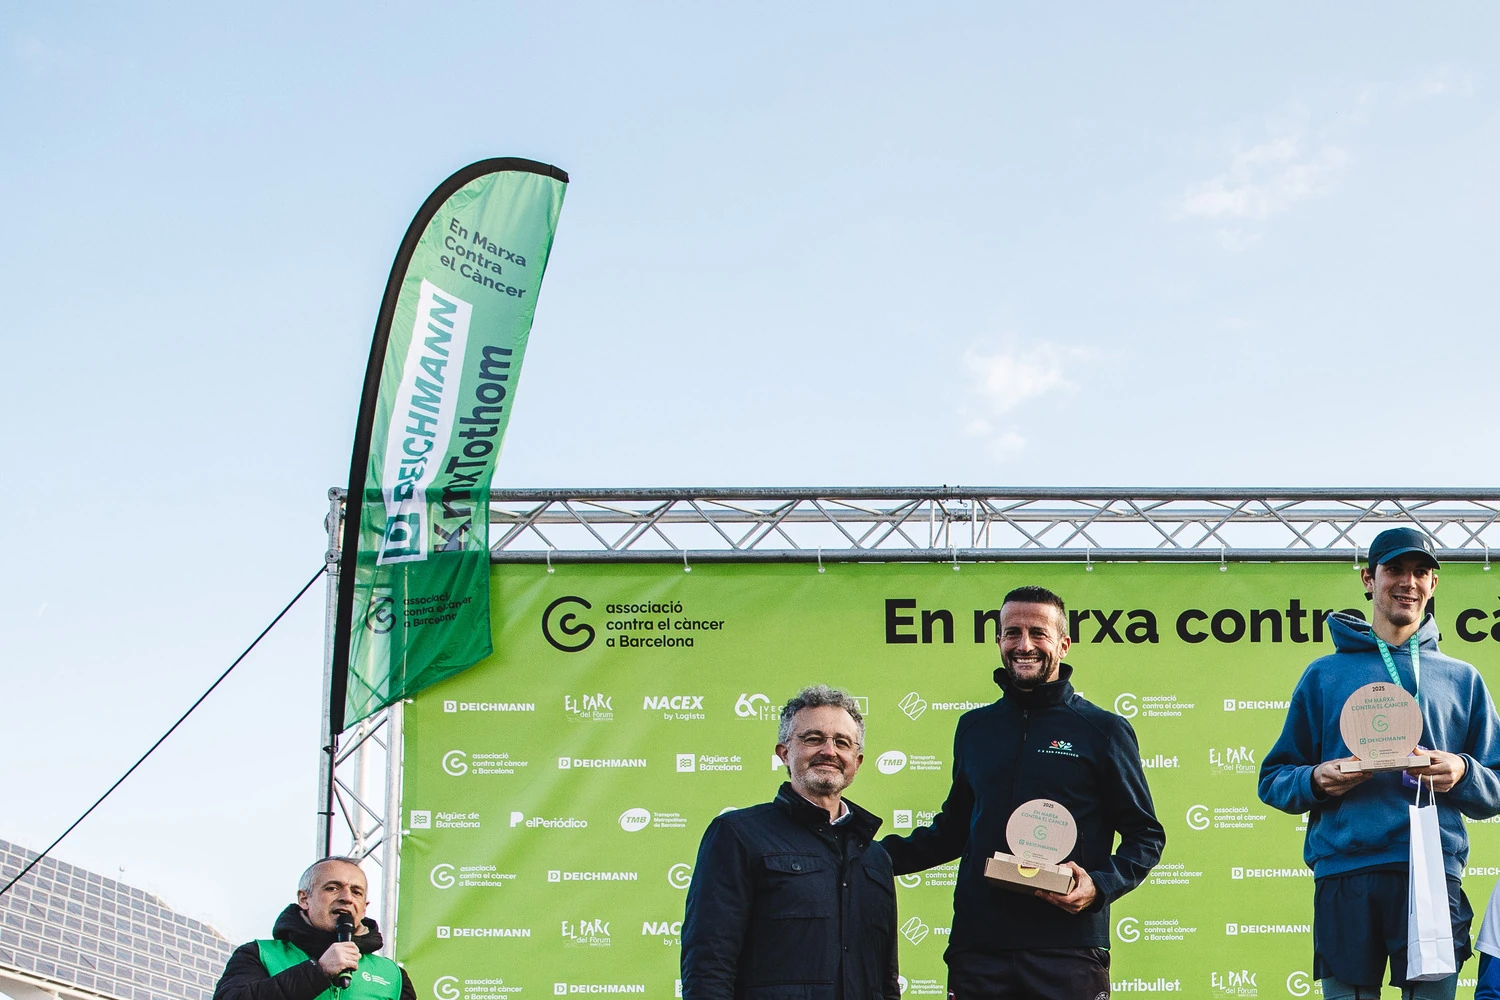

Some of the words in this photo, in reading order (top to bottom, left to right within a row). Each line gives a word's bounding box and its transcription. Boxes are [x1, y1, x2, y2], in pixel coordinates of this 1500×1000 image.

[450, 217, 468, 240] En
[472, 231, 526, 267] Marxa
[445, 236, 502, 275] Contra
[440, 255, 456, 272] el
[460, 264, 526, 298] Càncer
[403, 592, 450, 605] associaci
[606, 600, 683, 613] associació
[414, 613, 457, 627] Barceona
[606, 618, 653, 630] contra
[657, 618, 670, 630] el
[674, 617, 724, 630] càncer
[885, 599, 954, 644] En
[973, 609, 1159, 644] rxa
[606, 638, 615, 647] a
[620, 635, 694, 647] Barcelona
[460, 703, 535, 711] DEICHMANN
[565, 695, 580, 714] EL
[643, 696, 704, 710] NACEX
[675, 713, 705, 721] Logista
[574, 759, 646, 768] DEICHMANN
[699, 755, 728, 764] Aigües
[700, 763, 742, 771] Barcelona
[525, 817, 588, 828] elPeriódico
[626, 815, 647, 823] TMB
[454, 928, 530, 937] DEICHMANN
[1241, 925, 1310, 933] DEICHMANN
[1211, 972, 1226, 990] EL
